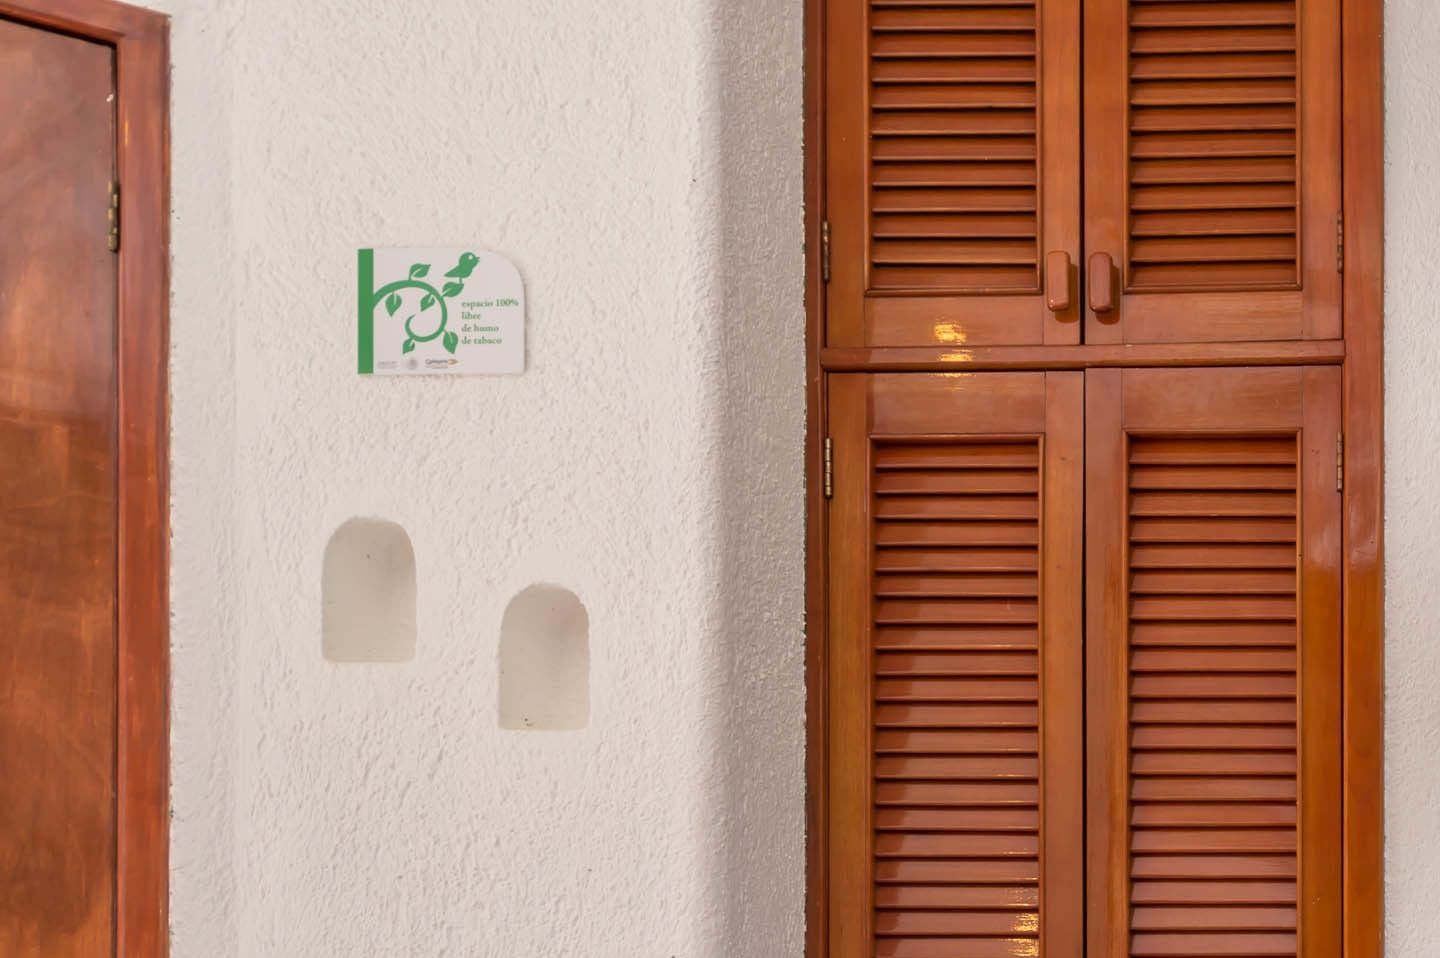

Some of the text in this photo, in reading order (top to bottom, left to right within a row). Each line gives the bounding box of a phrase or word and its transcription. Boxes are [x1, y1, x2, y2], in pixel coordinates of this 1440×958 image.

[461, 298, 519, 310] espacio 100%
[461, 311, 481, 320] libre
[461, 323, 499, 332] de humo
[461, 336, 502, 345] de tabaco
